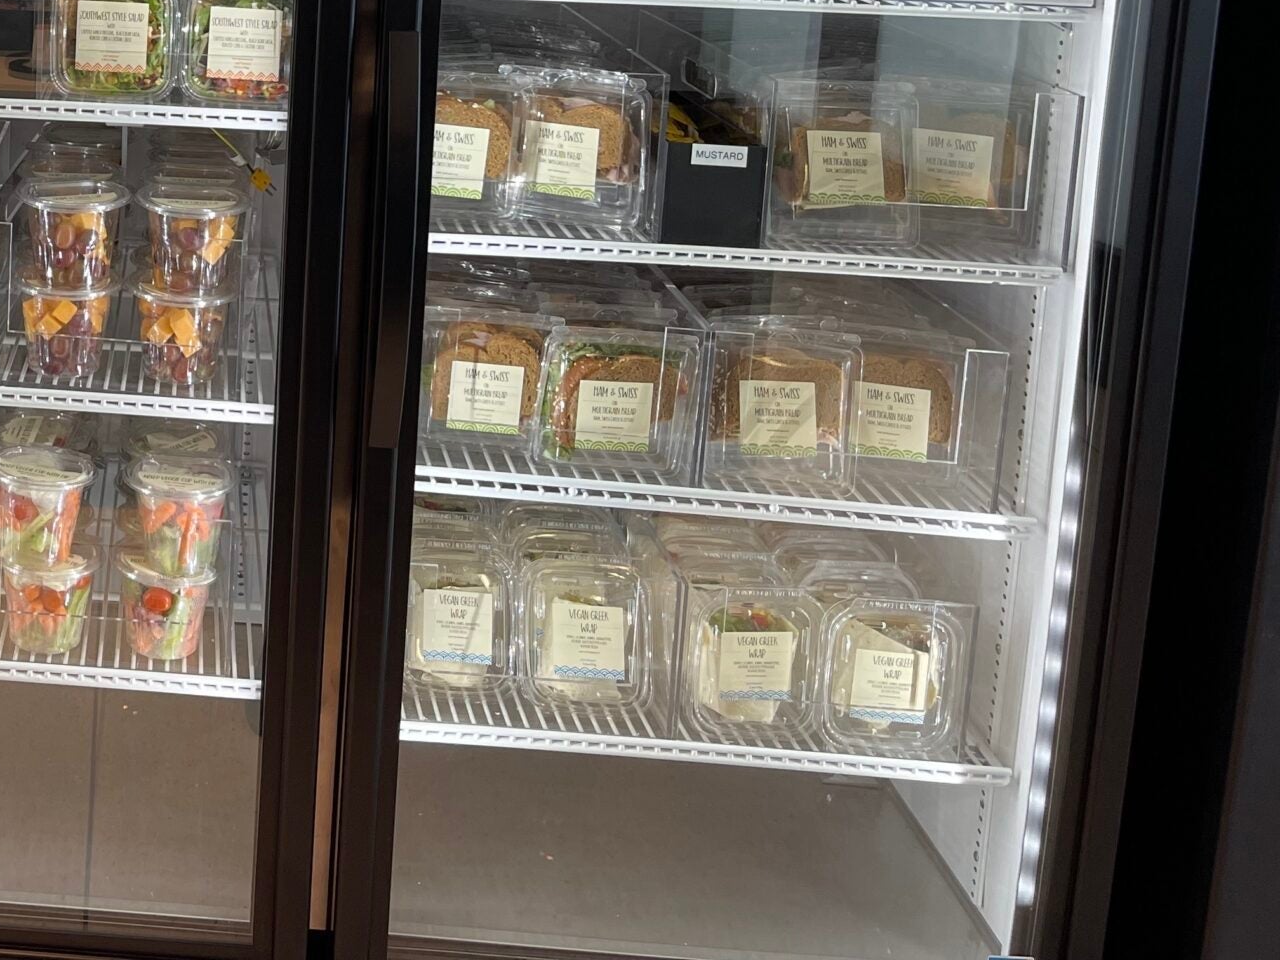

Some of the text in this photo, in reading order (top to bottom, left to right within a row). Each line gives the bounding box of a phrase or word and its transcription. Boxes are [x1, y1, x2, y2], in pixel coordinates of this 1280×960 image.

[79, 10, 144, 22] SOUTHWEST STYLE SALAD
[212, 17, 277, 29] SOUTHWEST STYLE SALAD
[538, 127, 554, 141] HAM
[564, 130, 584, 144] SWISS
[821, 136, 837, 149] HAM
[846, 137, 867, 149] SWISS
[928, 136, 944, 147] HAM
[954, 141, 977, 152] SWISS
[695, 149, 744, 161] MUSTARD
[465, 368, 480, 380] HAM
[489, 370, 510, 382] SWISS
[593, 386, 609, 398] HAM
[617, 387, 638, 398] SWISS
[754, 386, 770, 399] HAM
[779, 388, 800, 399] SWISS
[867, 388, 883, 400] HAM
[893, 392, 915, 405] SWISS
[439, 594, 479, 608] VEGAN GREEK
[450, 609, 467, 619] WRAP
[568, 608, 608, 621] VEGAN GREEK
[580, 623, 598, 634] WRAP
[737, 636, 778, 646] VEGAN GREEK
[749, 650, 766, 659] WRAP
[873, 655, 894, 667] VEGAN
[883, 669, 902, 681] WRAP
